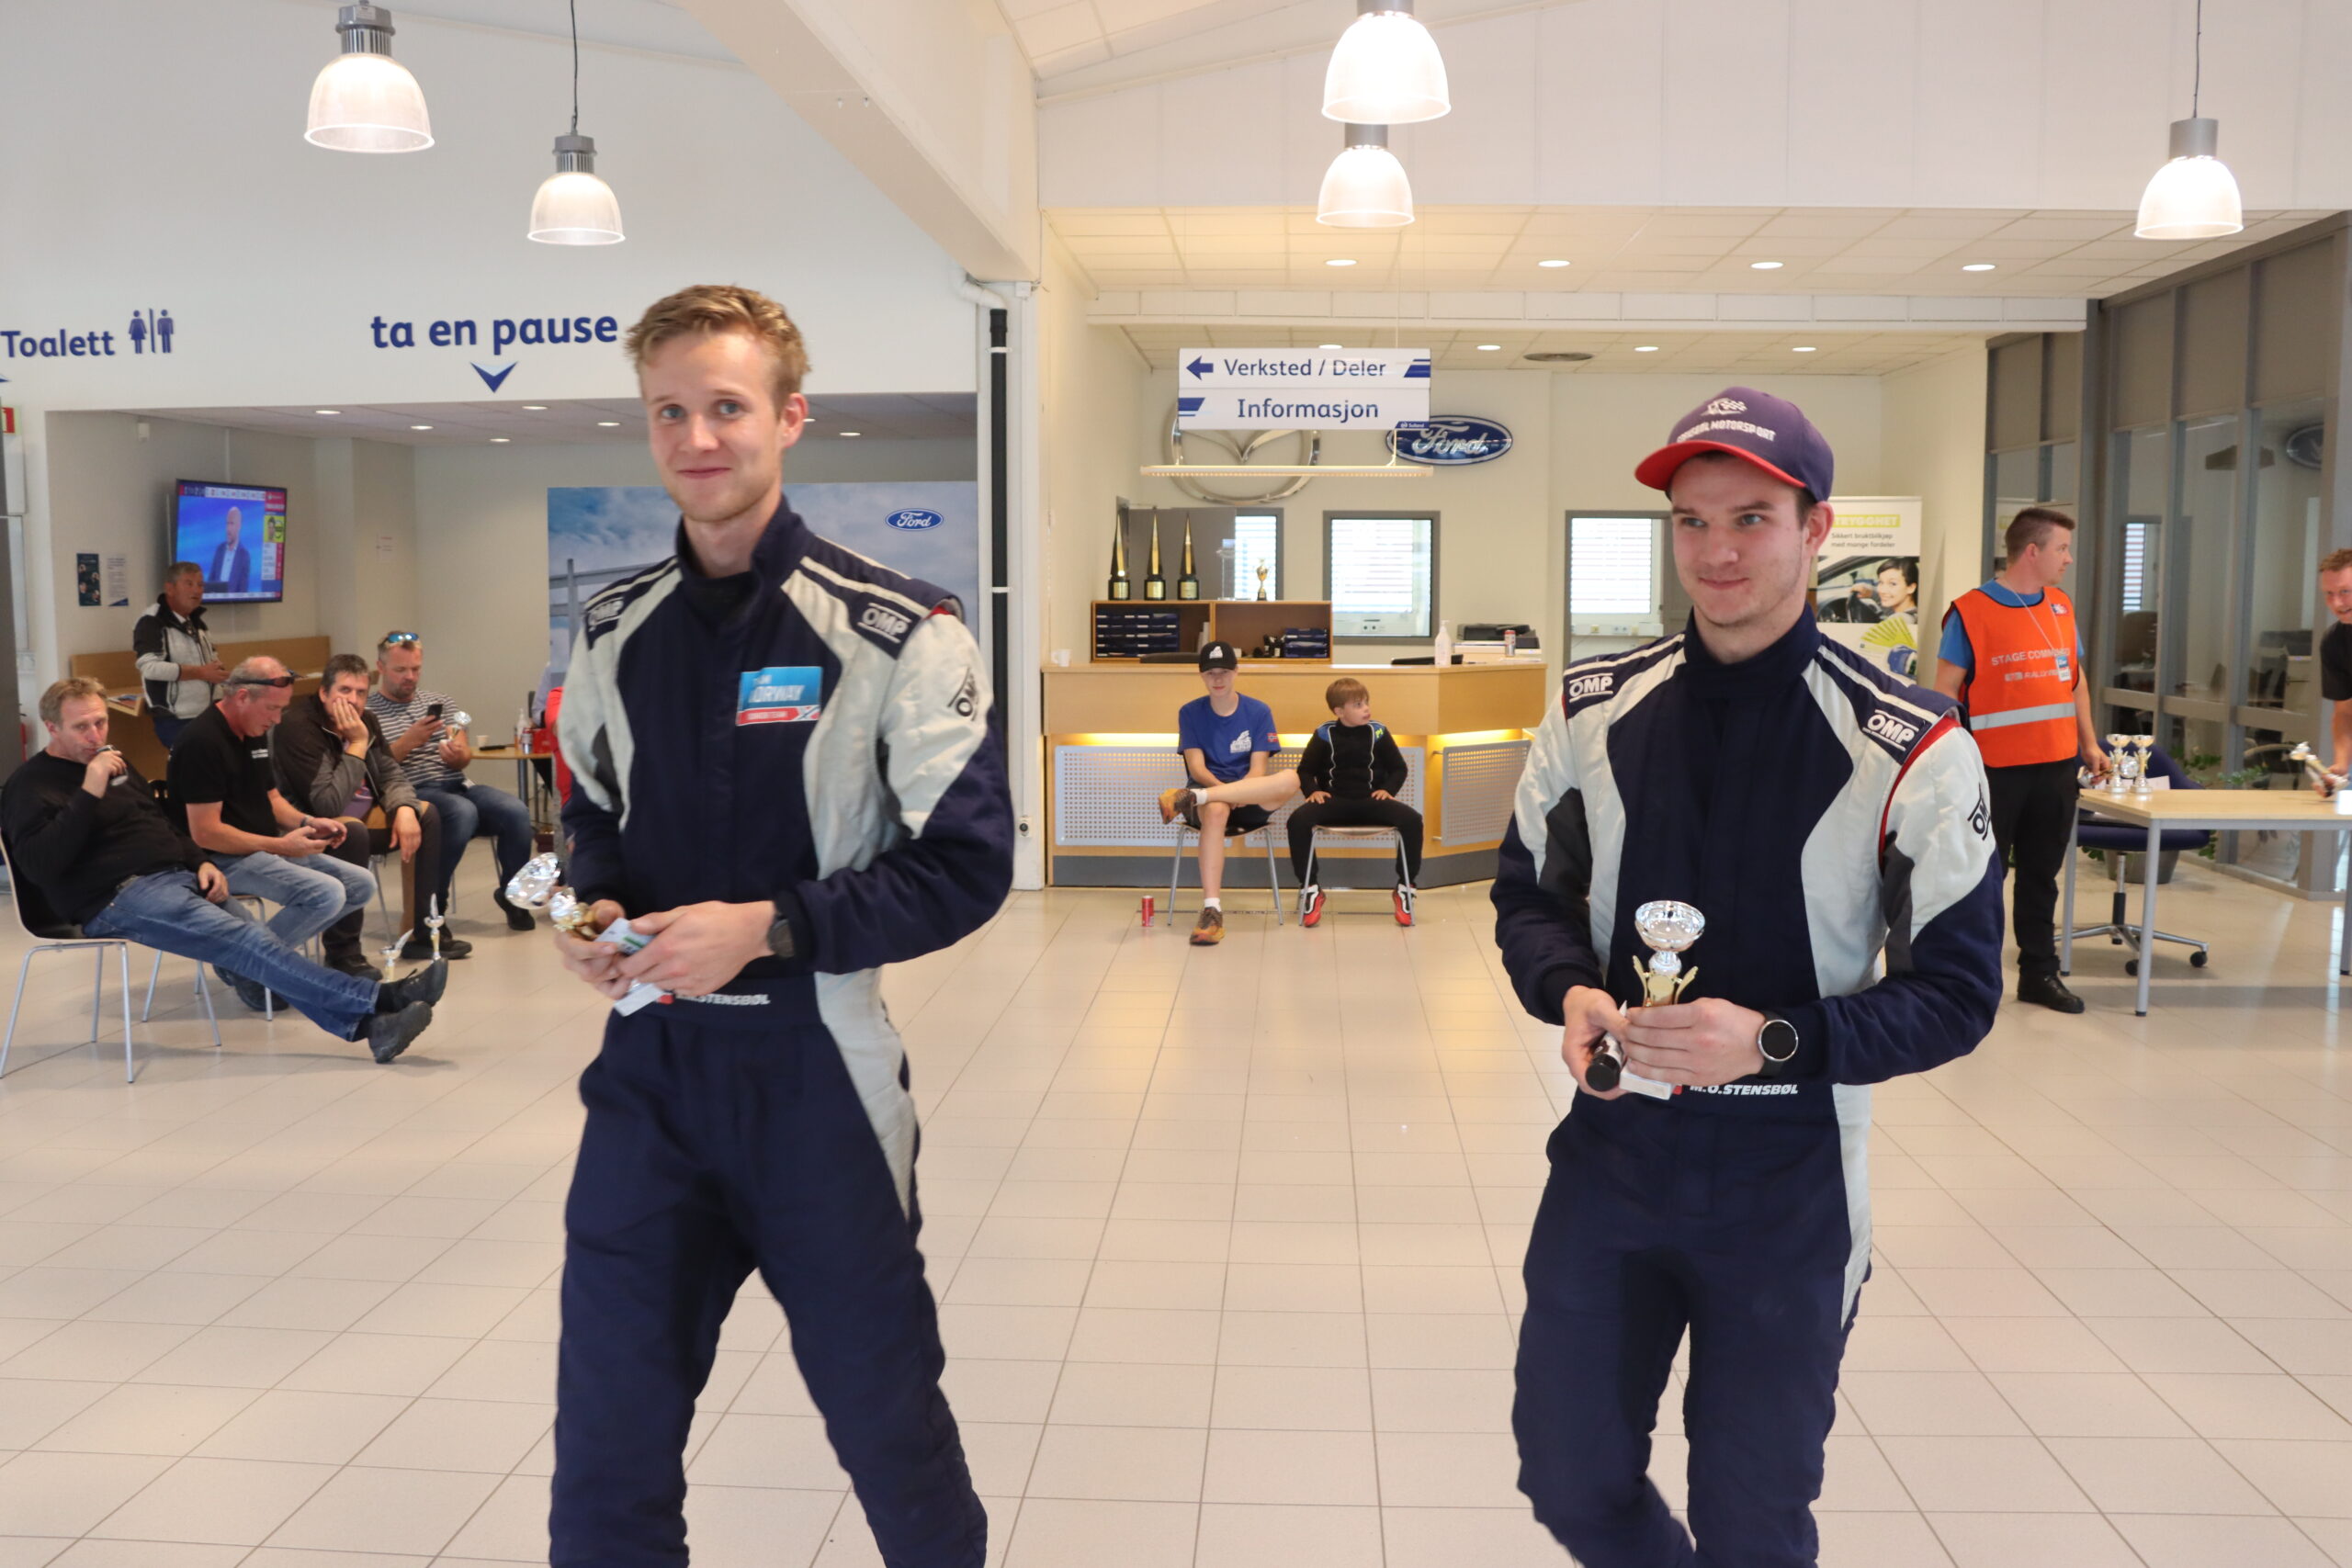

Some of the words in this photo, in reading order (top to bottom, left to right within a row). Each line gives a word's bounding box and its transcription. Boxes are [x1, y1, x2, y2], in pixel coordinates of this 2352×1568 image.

[0, 329, 116, 358] Toalett
[370, 316, 415, 348] ta
[429, 320, 477, 346] en
[493, 316, 617, 355] pause
[1224, 359, 1312, 377] Verksted
[1333, 359, 1386, 377] Deler
[1238, 399, 1379, 423] Informasjon
[1411, 423, 1489, 455] Ford
[1710, 420, 1777, 443] MOTORSPORT
[897, 512, 933, 527] Ford
[862, 607, 909, 636] OMP
[1991, 651, 2028, 666] STAGE
[1569, 676, 1613, 697] OMP
[1867, 714, 1915, 744] OMP
